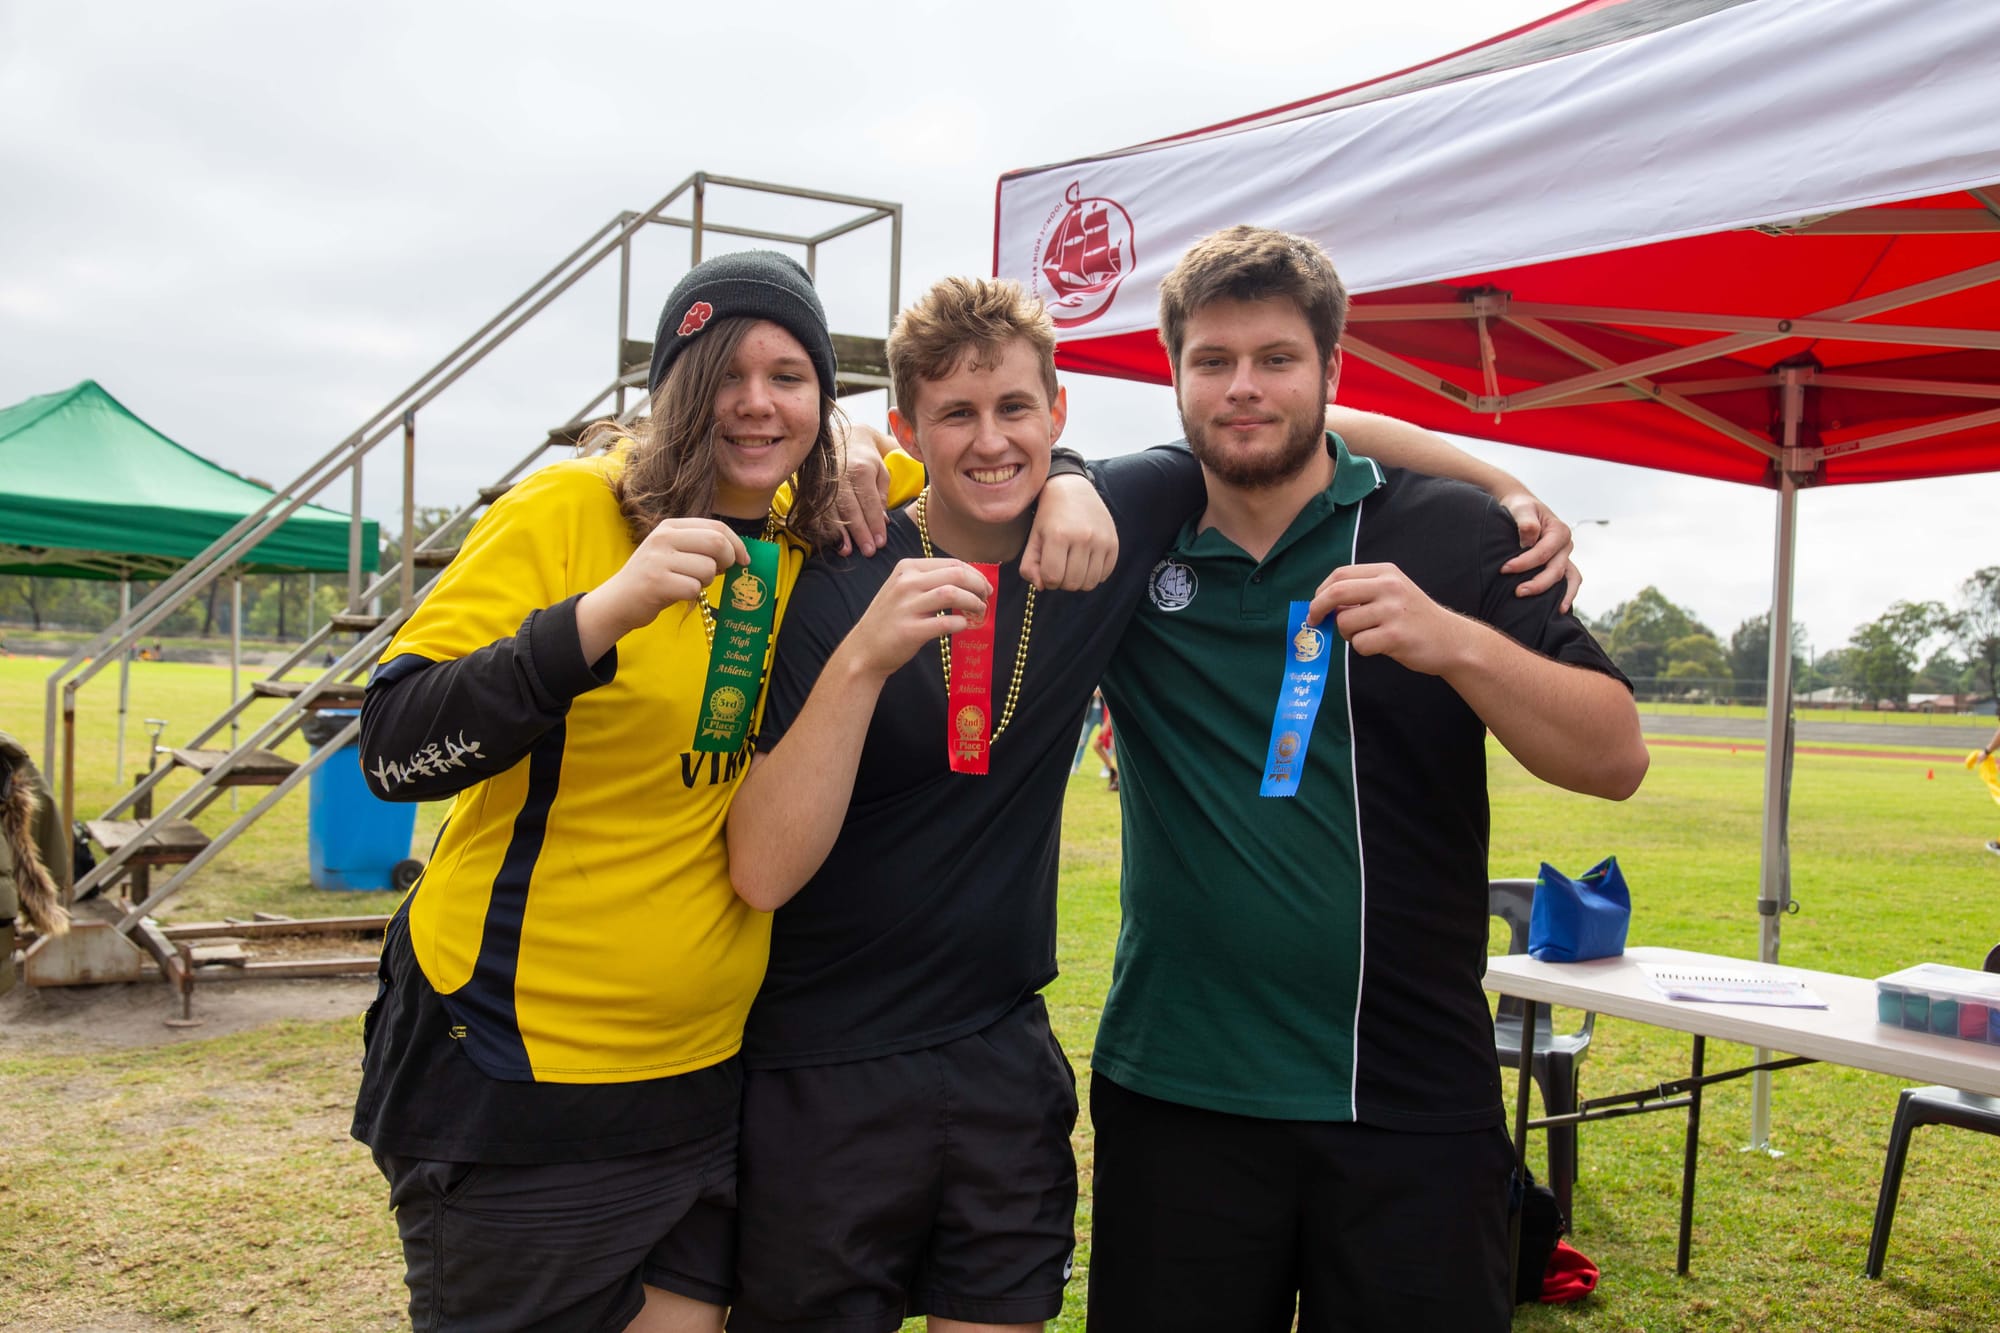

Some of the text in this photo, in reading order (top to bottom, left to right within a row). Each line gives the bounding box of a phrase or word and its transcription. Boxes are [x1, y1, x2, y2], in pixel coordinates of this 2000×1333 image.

[1033, 238, 1042, 262] HIGH
[1040, 202, 1063, 236] SCHOOL
[724, 619, 762, 634] Trafalgar
[729, 636, 751, 648] High
[959, 640, 989, 651] Trafalgar
[723, 650, 752, 662] School
[965, 656, 981, 667] High
[715, 664, 753, 678] Athletics
[962, 670, 984, 680] School
[956, 684, 986, 695] Athletics
[718, 698, 738, 709] 3rd
[709, 720, 736, 731] Place
[964, 717, 979, 727] 2nd
[959, 741, 981, 751] Place
